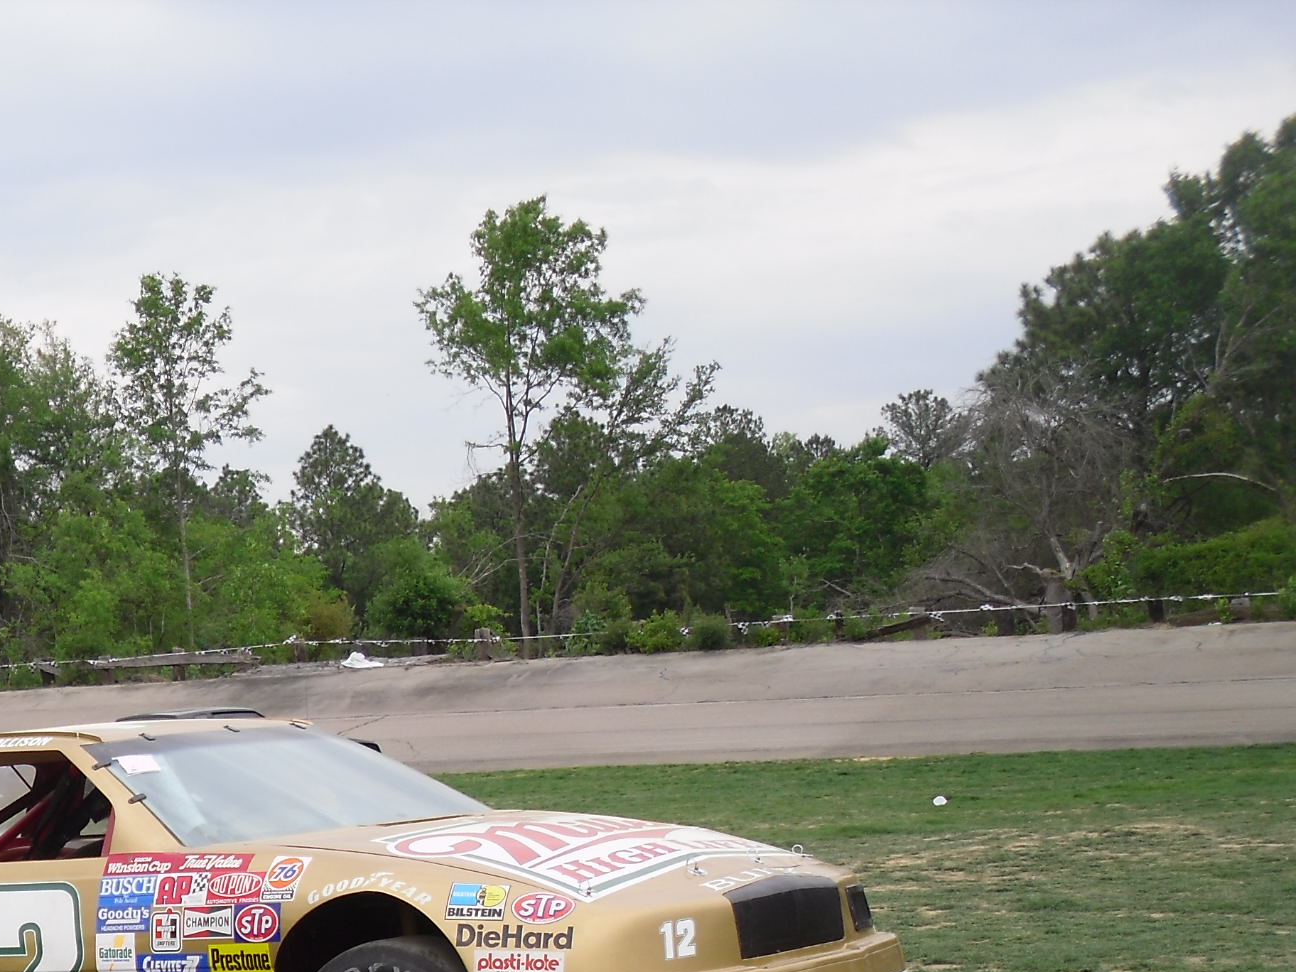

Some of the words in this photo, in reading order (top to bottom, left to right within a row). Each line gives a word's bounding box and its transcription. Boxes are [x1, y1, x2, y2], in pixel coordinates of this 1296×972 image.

[108, 862, 149, 873] Winston
[149, 861, 172, 873] Cup
[179, 855, 208, 870] True
[205, 854, 242, 870] Value
[271, 862, 301, 881] 76
[548, 842, 683, 882] HIGH
[101, 876, 156, 895] BUSCH
[155, 876, 193, 905] AP
[307, 872, 432, 905] GOODYEAR
[98, 907, 149, 924] Goody's
[448, 908, 502, 918] BILSTEIN
[519, 894, 567, 918] STP
[186, 915, 230, 928] CHAMPION
[241, 909, 273, 937] STP
[456, 923, 574, 949] DieHard
[659, 919, 697, 960] 12
[99, 947, 133, 959] Gatorade
[211, 948, 271, 971] Prestone
[478, 953, 560, 971] plasti-kote
